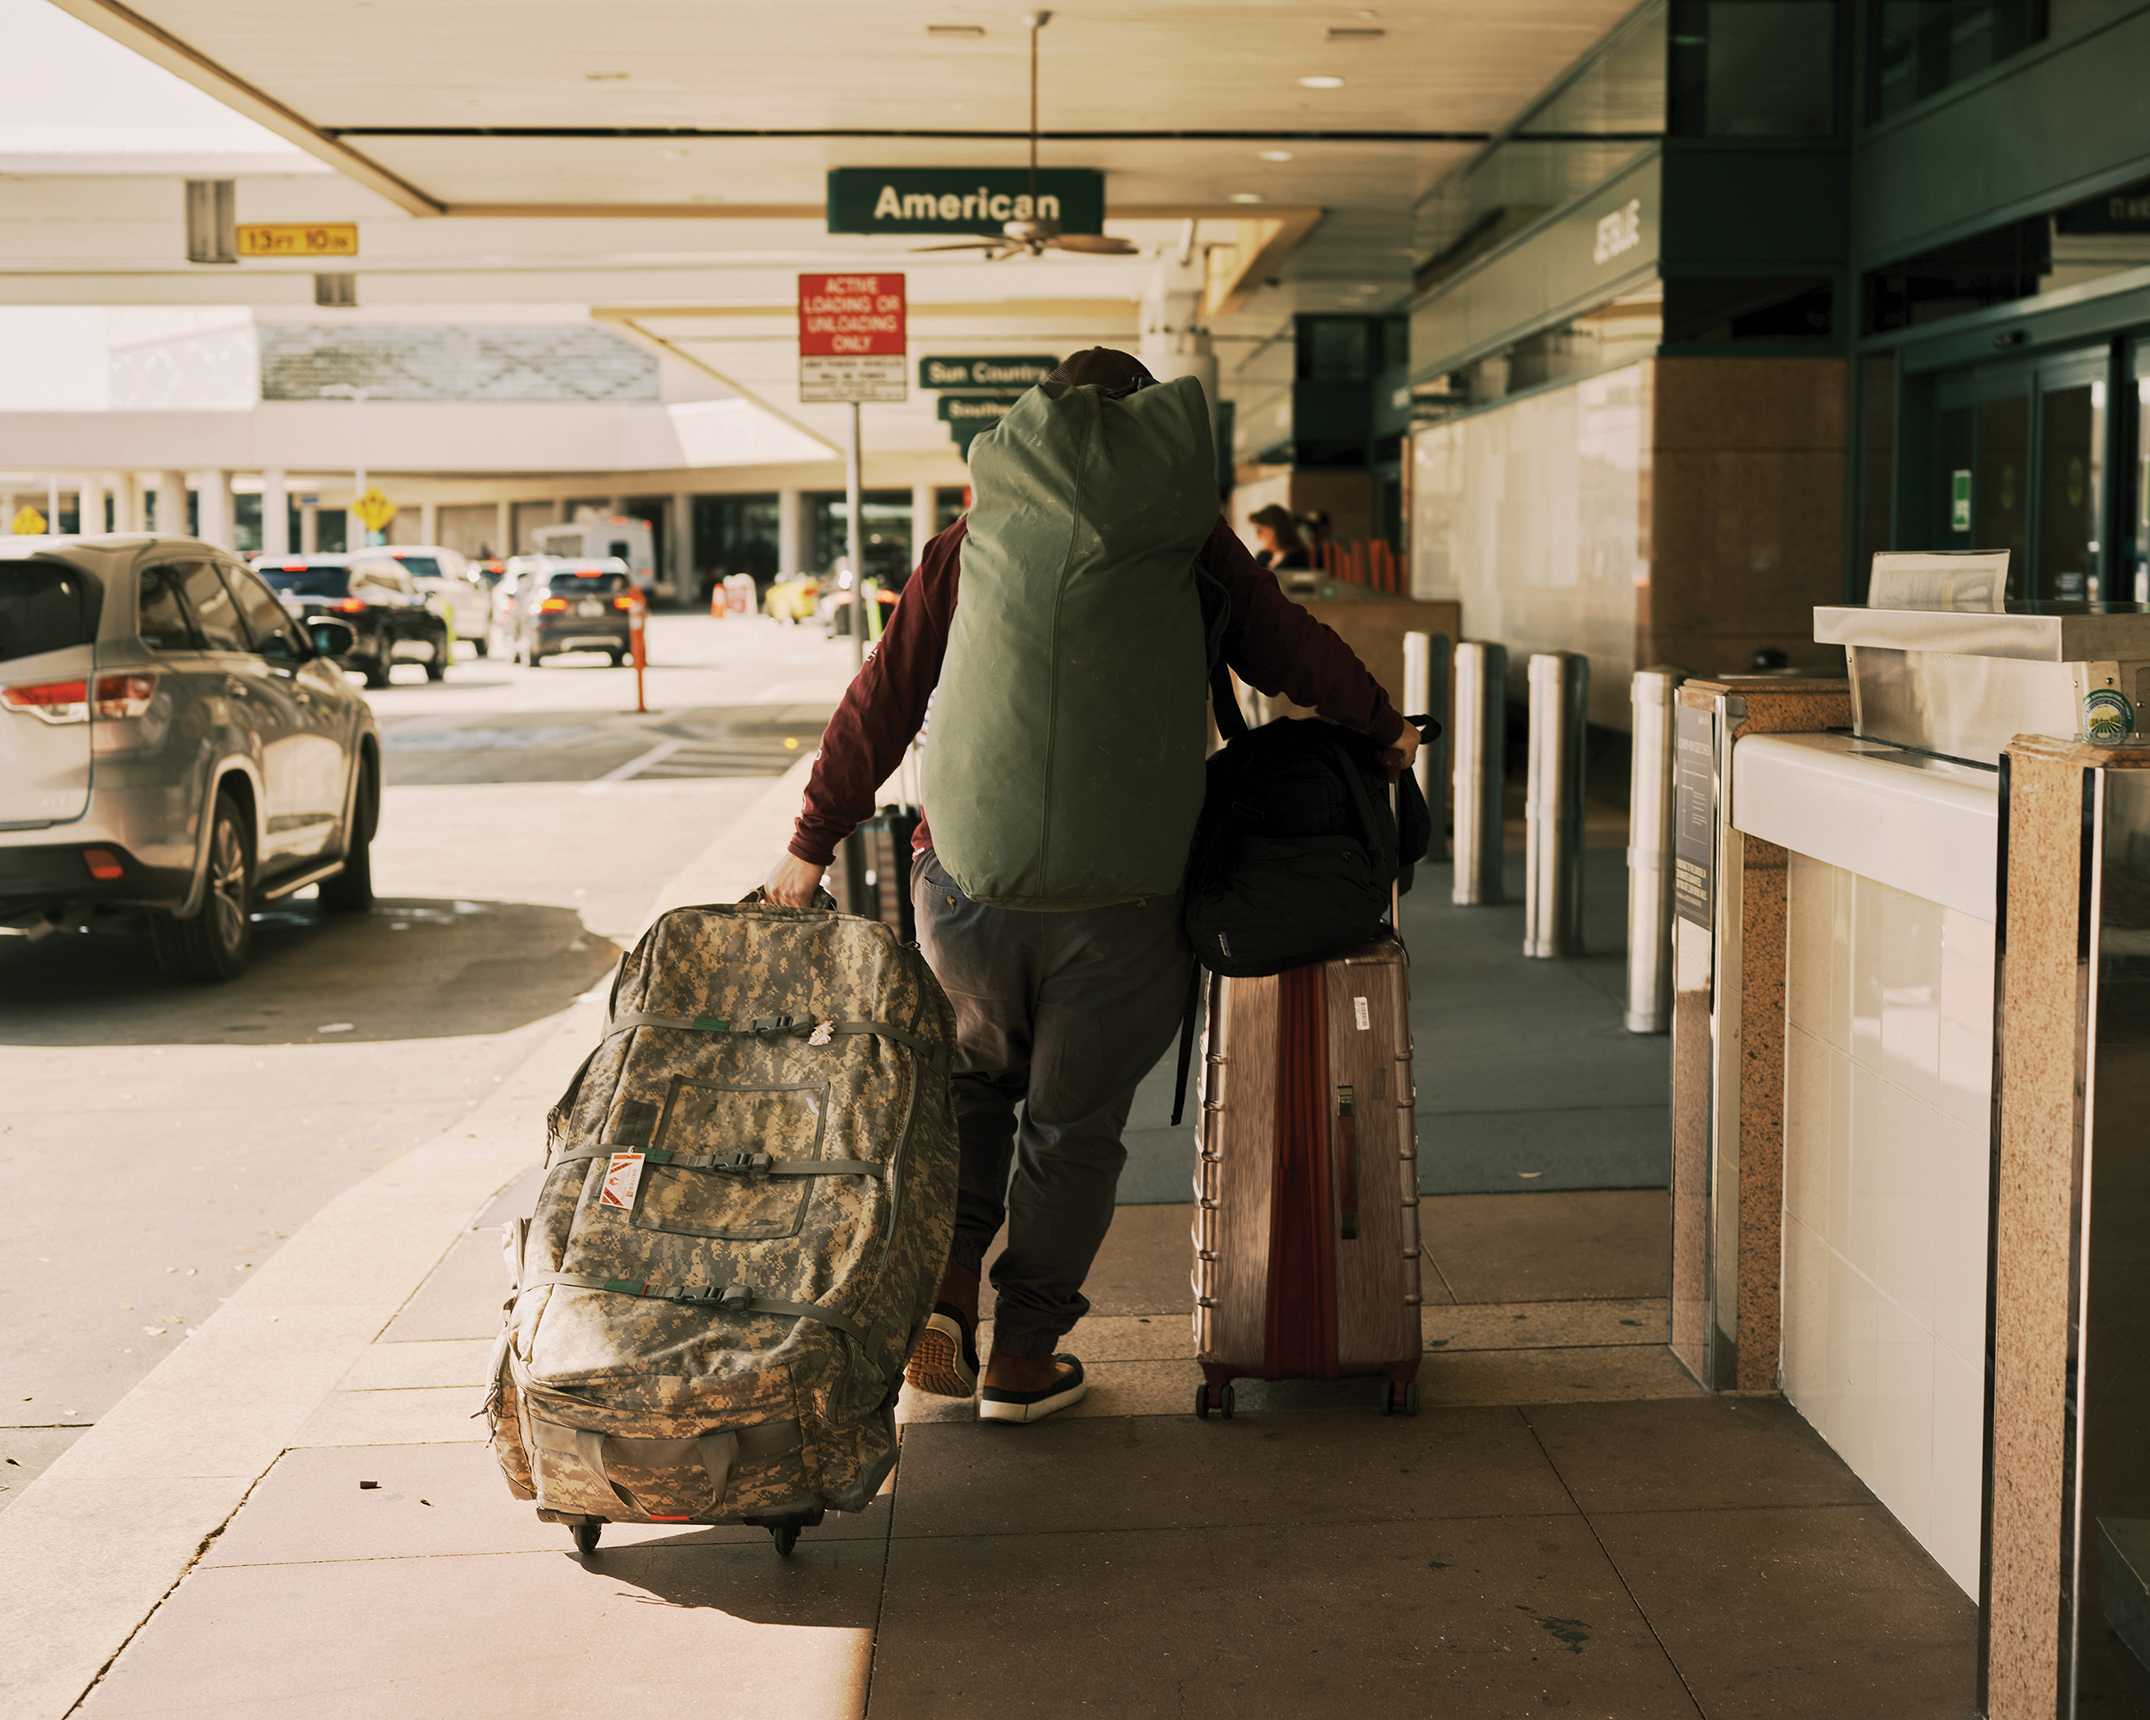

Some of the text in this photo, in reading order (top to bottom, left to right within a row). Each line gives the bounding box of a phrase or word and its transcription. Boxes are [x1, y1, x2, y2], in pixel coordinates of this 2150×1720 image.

[874, 185, 1060, 221] American
[824, 276, 879, 295] ACTIVE
[803, 294, 901, 314] LOADING OR
[806, 314, 898, 334] UNLOADING
[831, 334, 873, 353] ONLY
[929, 361, 1049, 386] Sun Country
[949, 400, 1012, 419] Southw
[628, 1168, 638, 1190] UNITED
